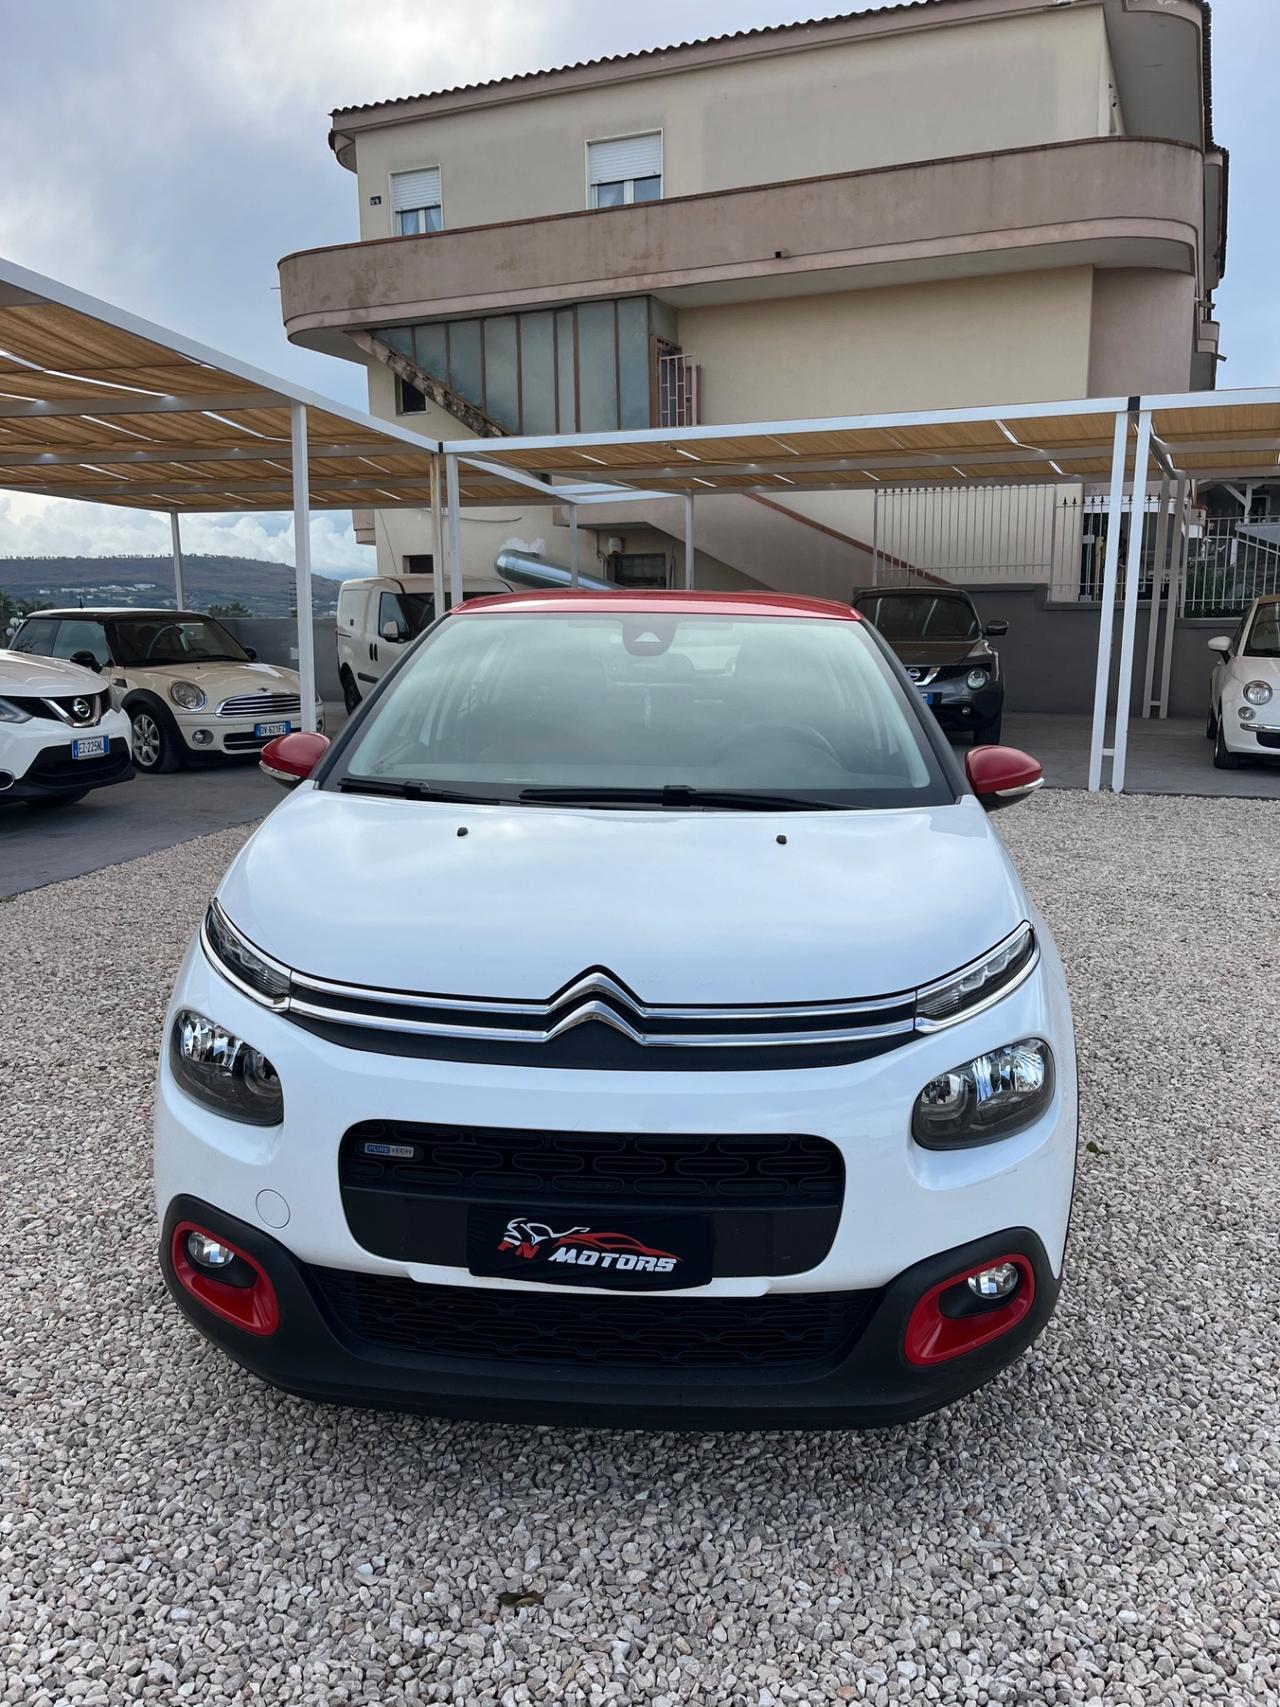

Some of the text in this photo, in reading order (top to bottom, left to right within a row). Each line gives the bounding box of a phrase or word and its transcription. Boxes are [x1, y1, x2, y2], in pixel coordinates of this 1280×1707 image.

[368, 1144, 389, 1153] PURE
[496, 1241, 677, 1273] FN MOTORS
